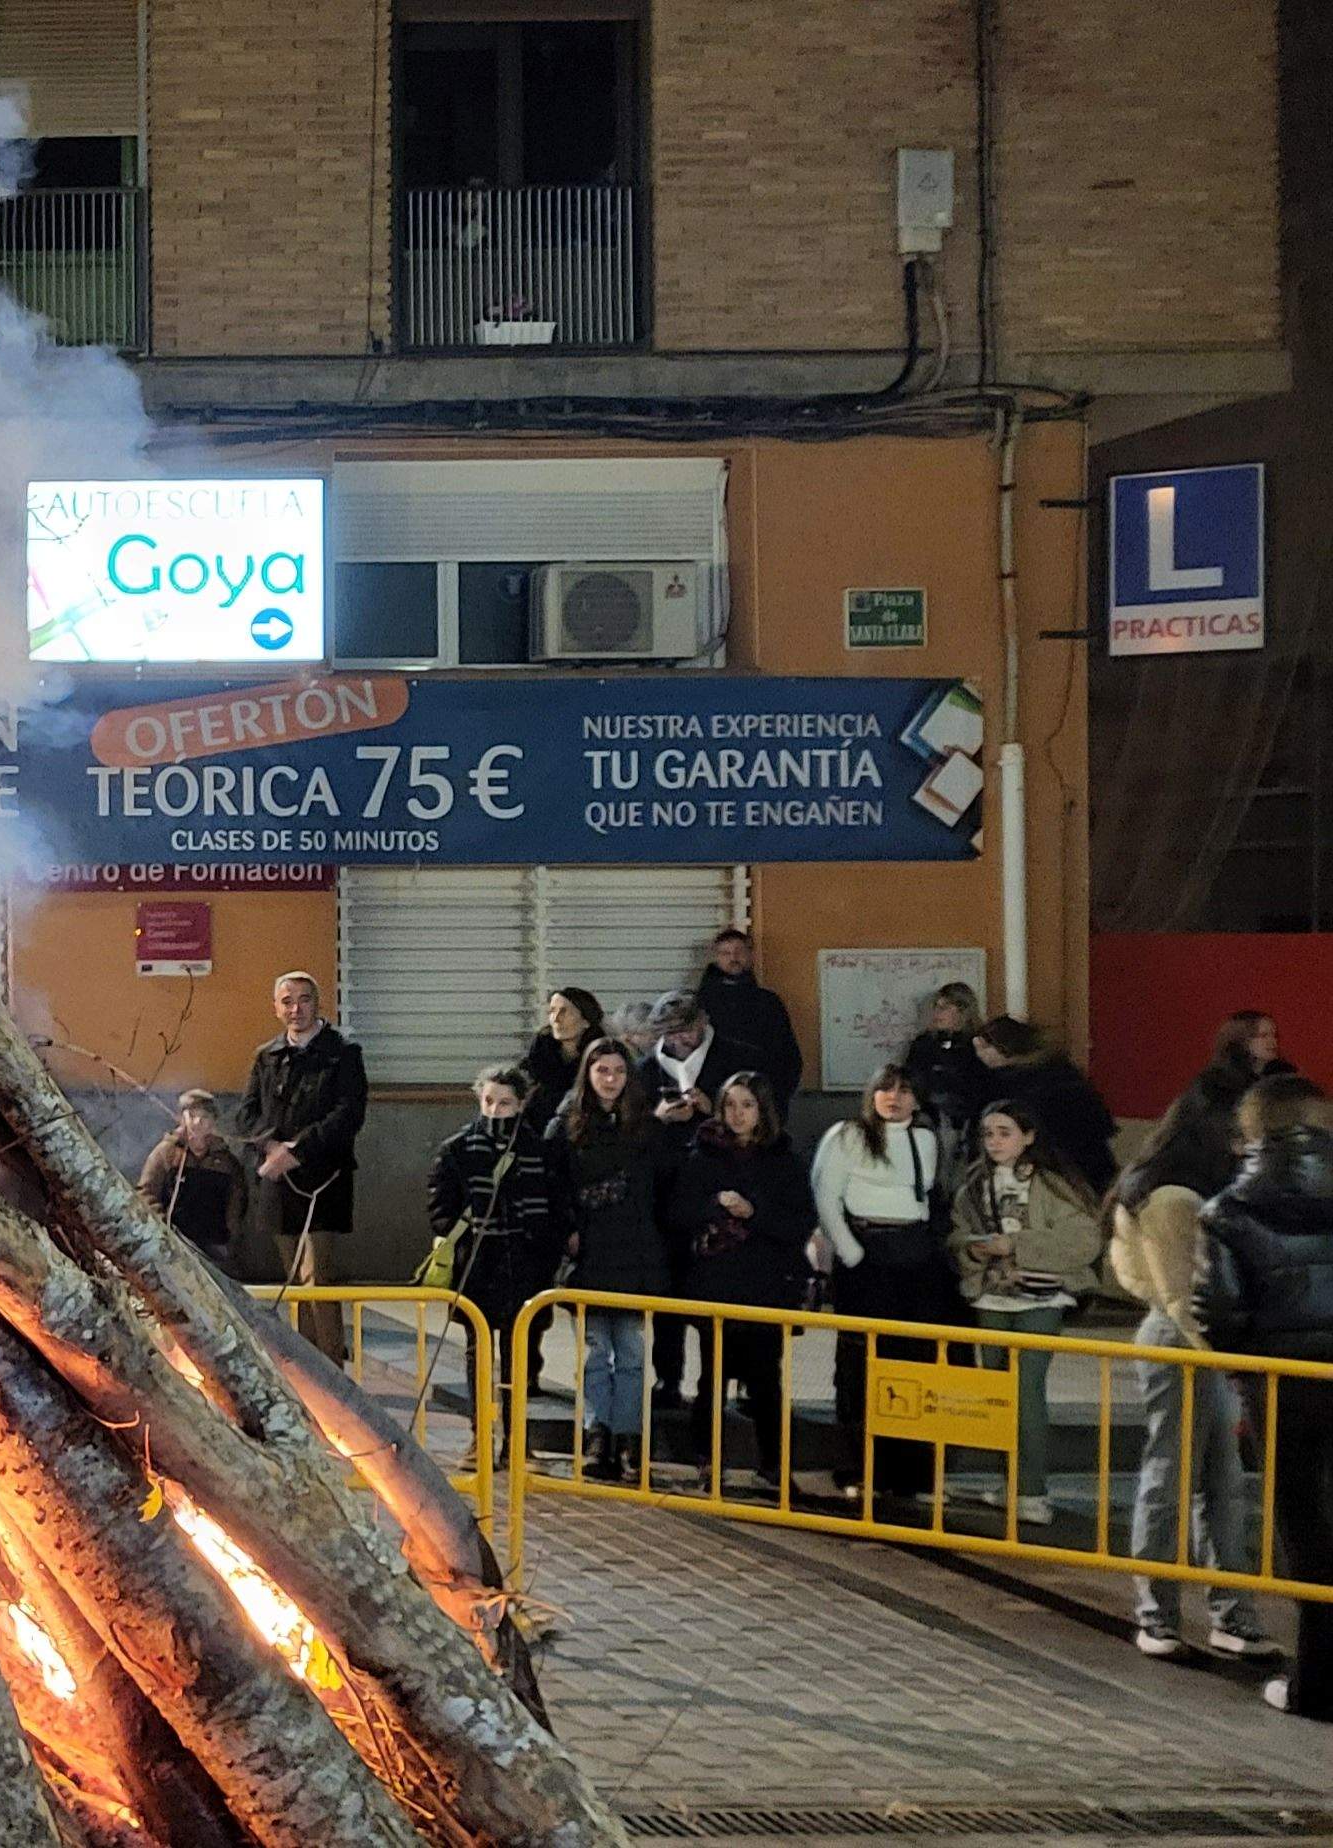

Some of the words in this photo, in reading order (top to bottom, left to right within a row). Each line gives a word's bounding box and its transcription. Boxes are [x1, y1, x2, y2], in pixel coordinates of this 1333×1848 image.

[46, 489, 303, 519] AUTOESCUELA
[1148, 486, 1223, 591] L
[108, 533, 304, 608] Goya
[1113, 612, 1260, 641] PRACTICAS
[125, 679, 379, 758] OFERTÓN
[583, 715, 704, 739] NUESTRA
[711, 713, 882, 739] EXPERIENCIA
[86, 753, 340, 817] TEÓRICA
[584, 749, 640, 789] TU
[654, 739, 883, 789] GARANTÍA
[584, 801, 644, 834] QUE
[652, 801, 697, 827] NO
[704, 801, 736, 826] TE
[744, 795, 882, 827] ENGAÑEN
[171, 829, 255, 851] CLASES
[262, 829, 293, 851] DE
[299, 829, 327, 851] 50
[333, 829, 440, 851] MINUTOS
